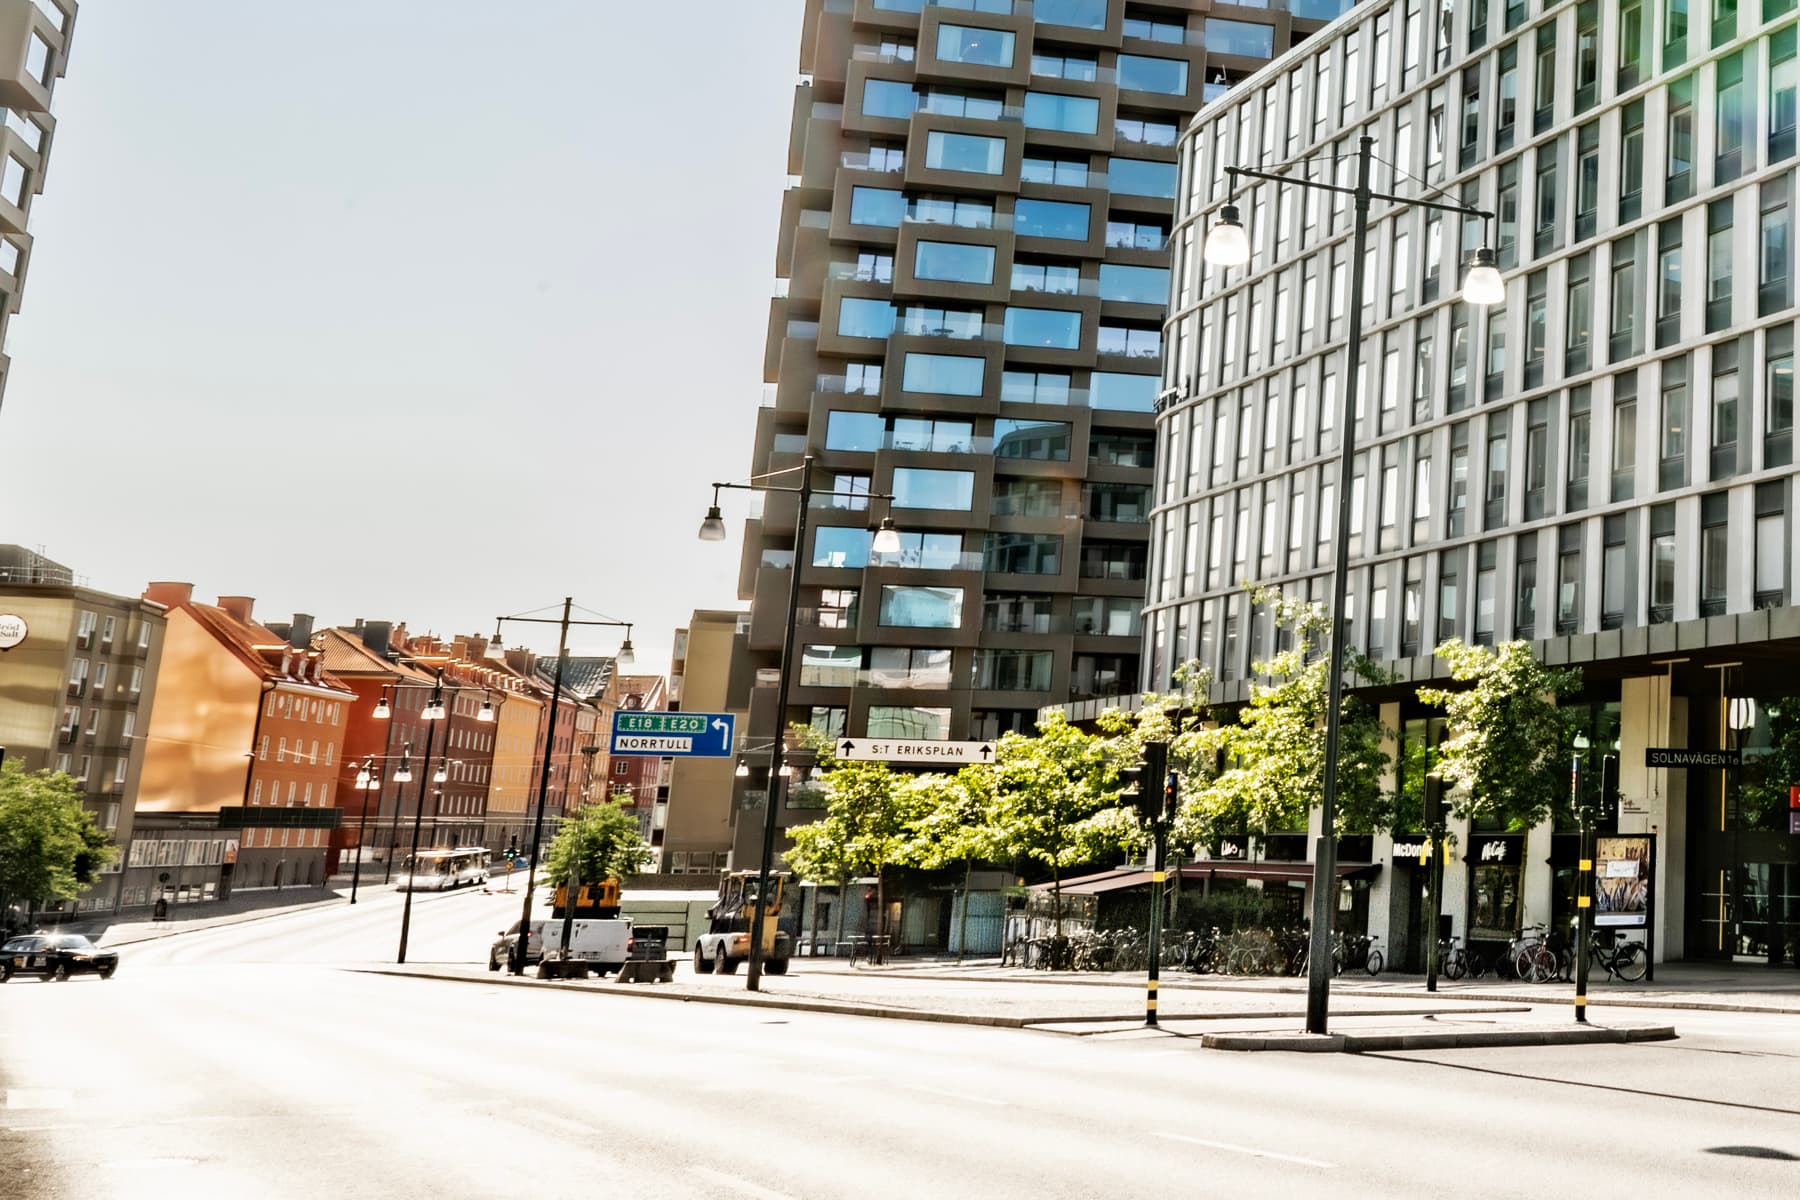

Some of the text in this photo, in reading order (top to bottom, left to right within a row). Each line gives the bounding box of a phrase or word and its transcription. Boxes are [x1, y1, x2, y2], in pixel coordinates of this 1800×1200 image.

[628, 718, 699, 730] E18 E20
[619, 738, 689, 750] NORRTULL
[871, 744, 964, 756] S:T ERIKSPLAN
[1651, 751, 1726, 766] SOLNAVÄGEN
